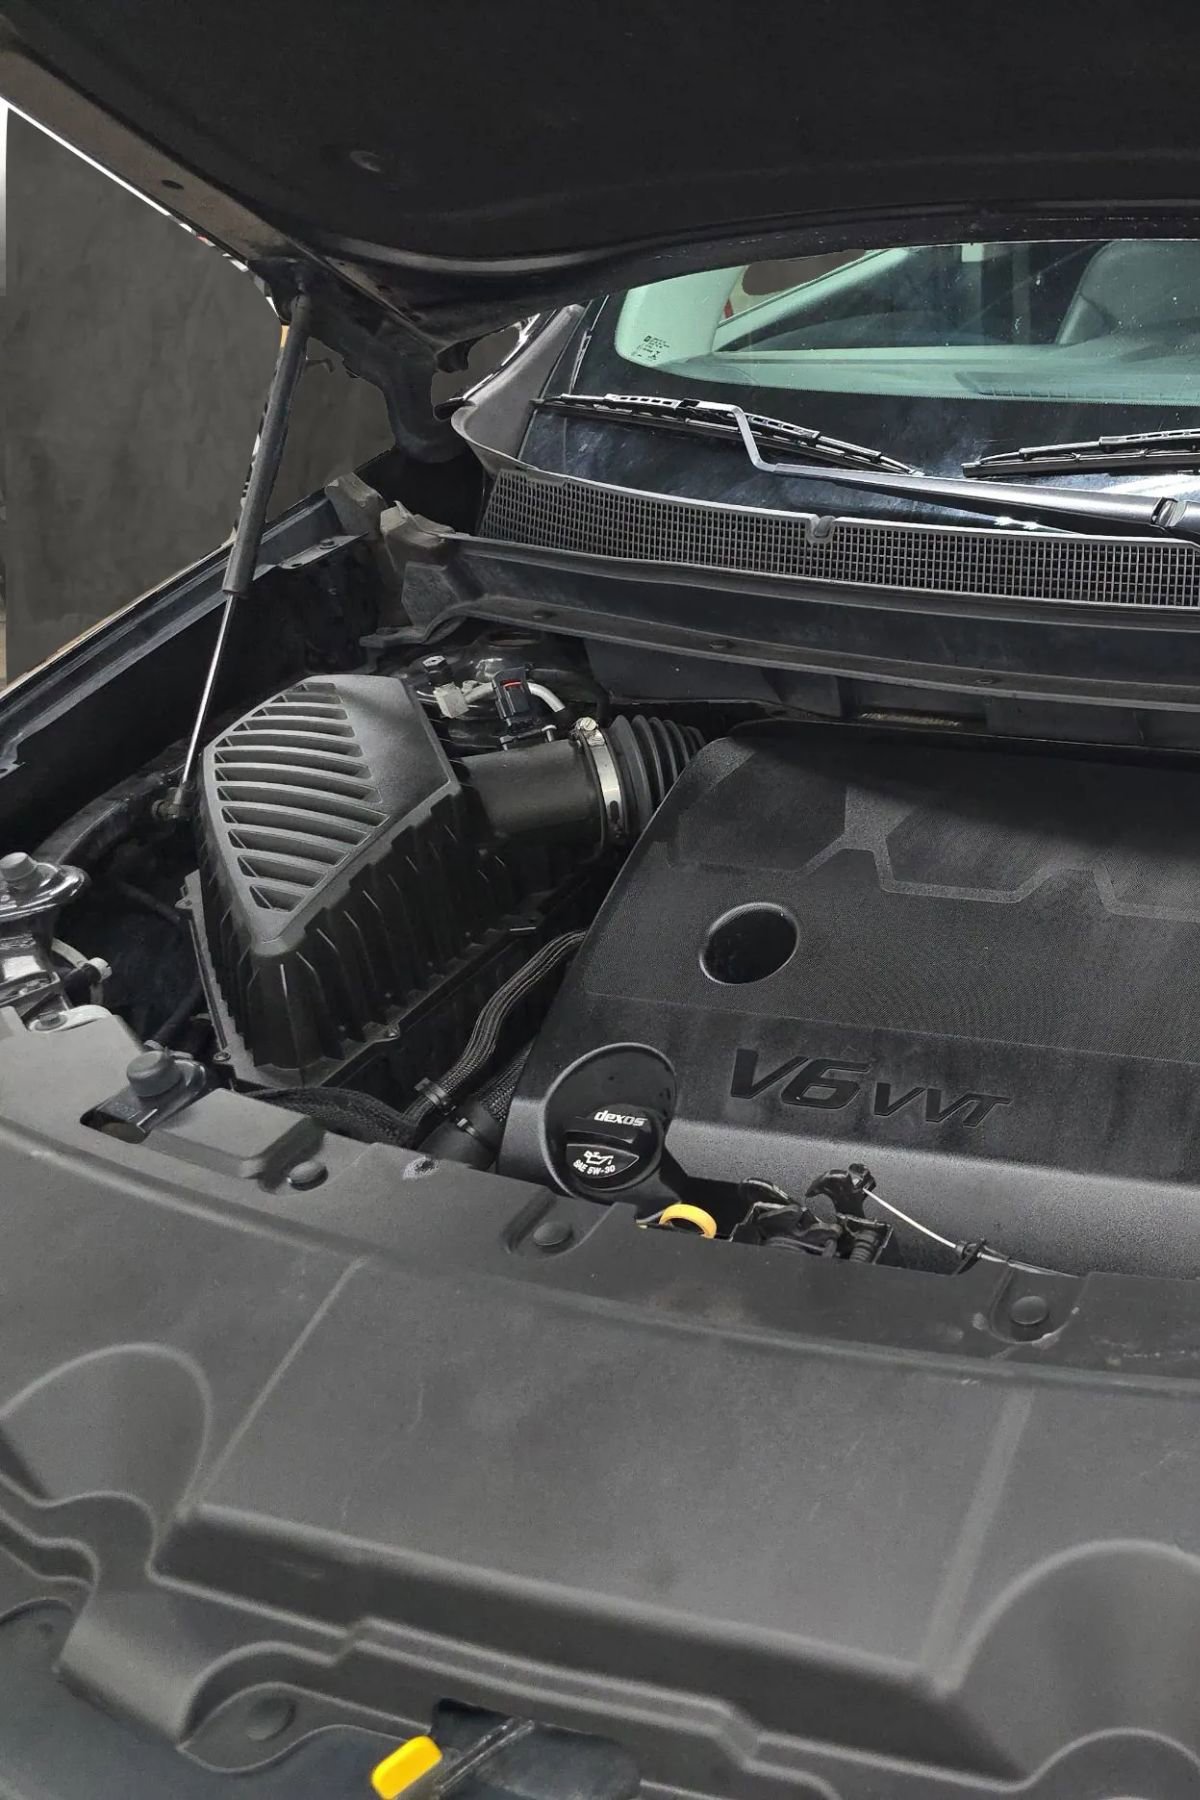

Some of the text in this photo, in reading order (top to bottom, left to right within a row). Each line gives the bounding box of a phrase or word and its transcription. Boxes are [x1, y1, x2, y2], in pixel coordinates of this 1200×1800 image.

[731, 1049, 1012, 1128] V6 VVT
[594, 1110, 648, 1127] dexos
[573, 1159, 616, 1176] SAE 5W-30
